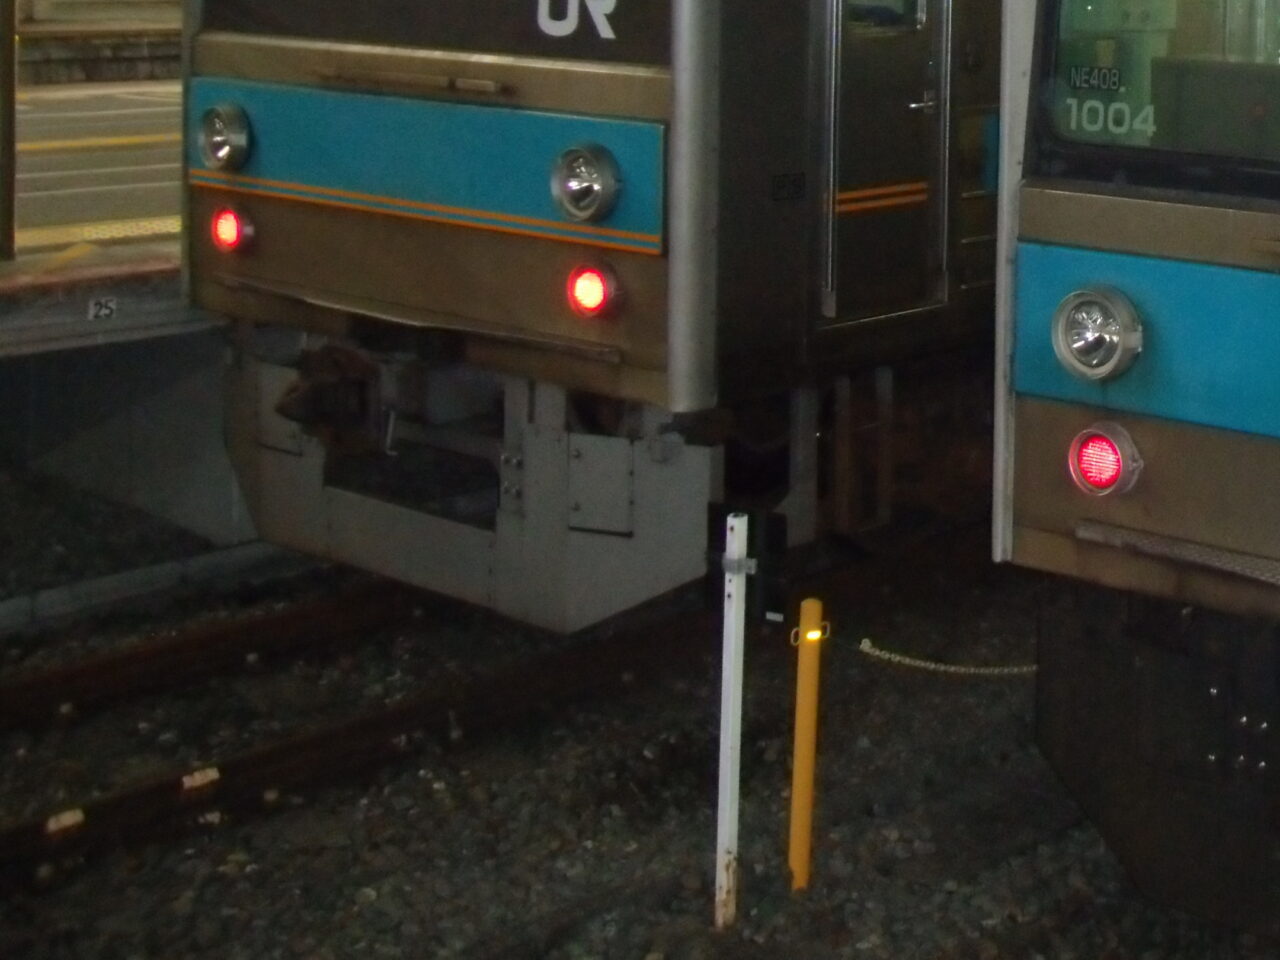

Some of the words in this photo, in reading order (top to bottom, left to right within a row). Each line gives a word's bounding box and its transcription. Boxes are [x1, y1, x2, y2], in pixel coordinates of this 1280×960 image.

[1070, 66, 1120, 90] NE408
[1065, 97, 1157, 137] 1004
[94, 298, 114, 319] 25
